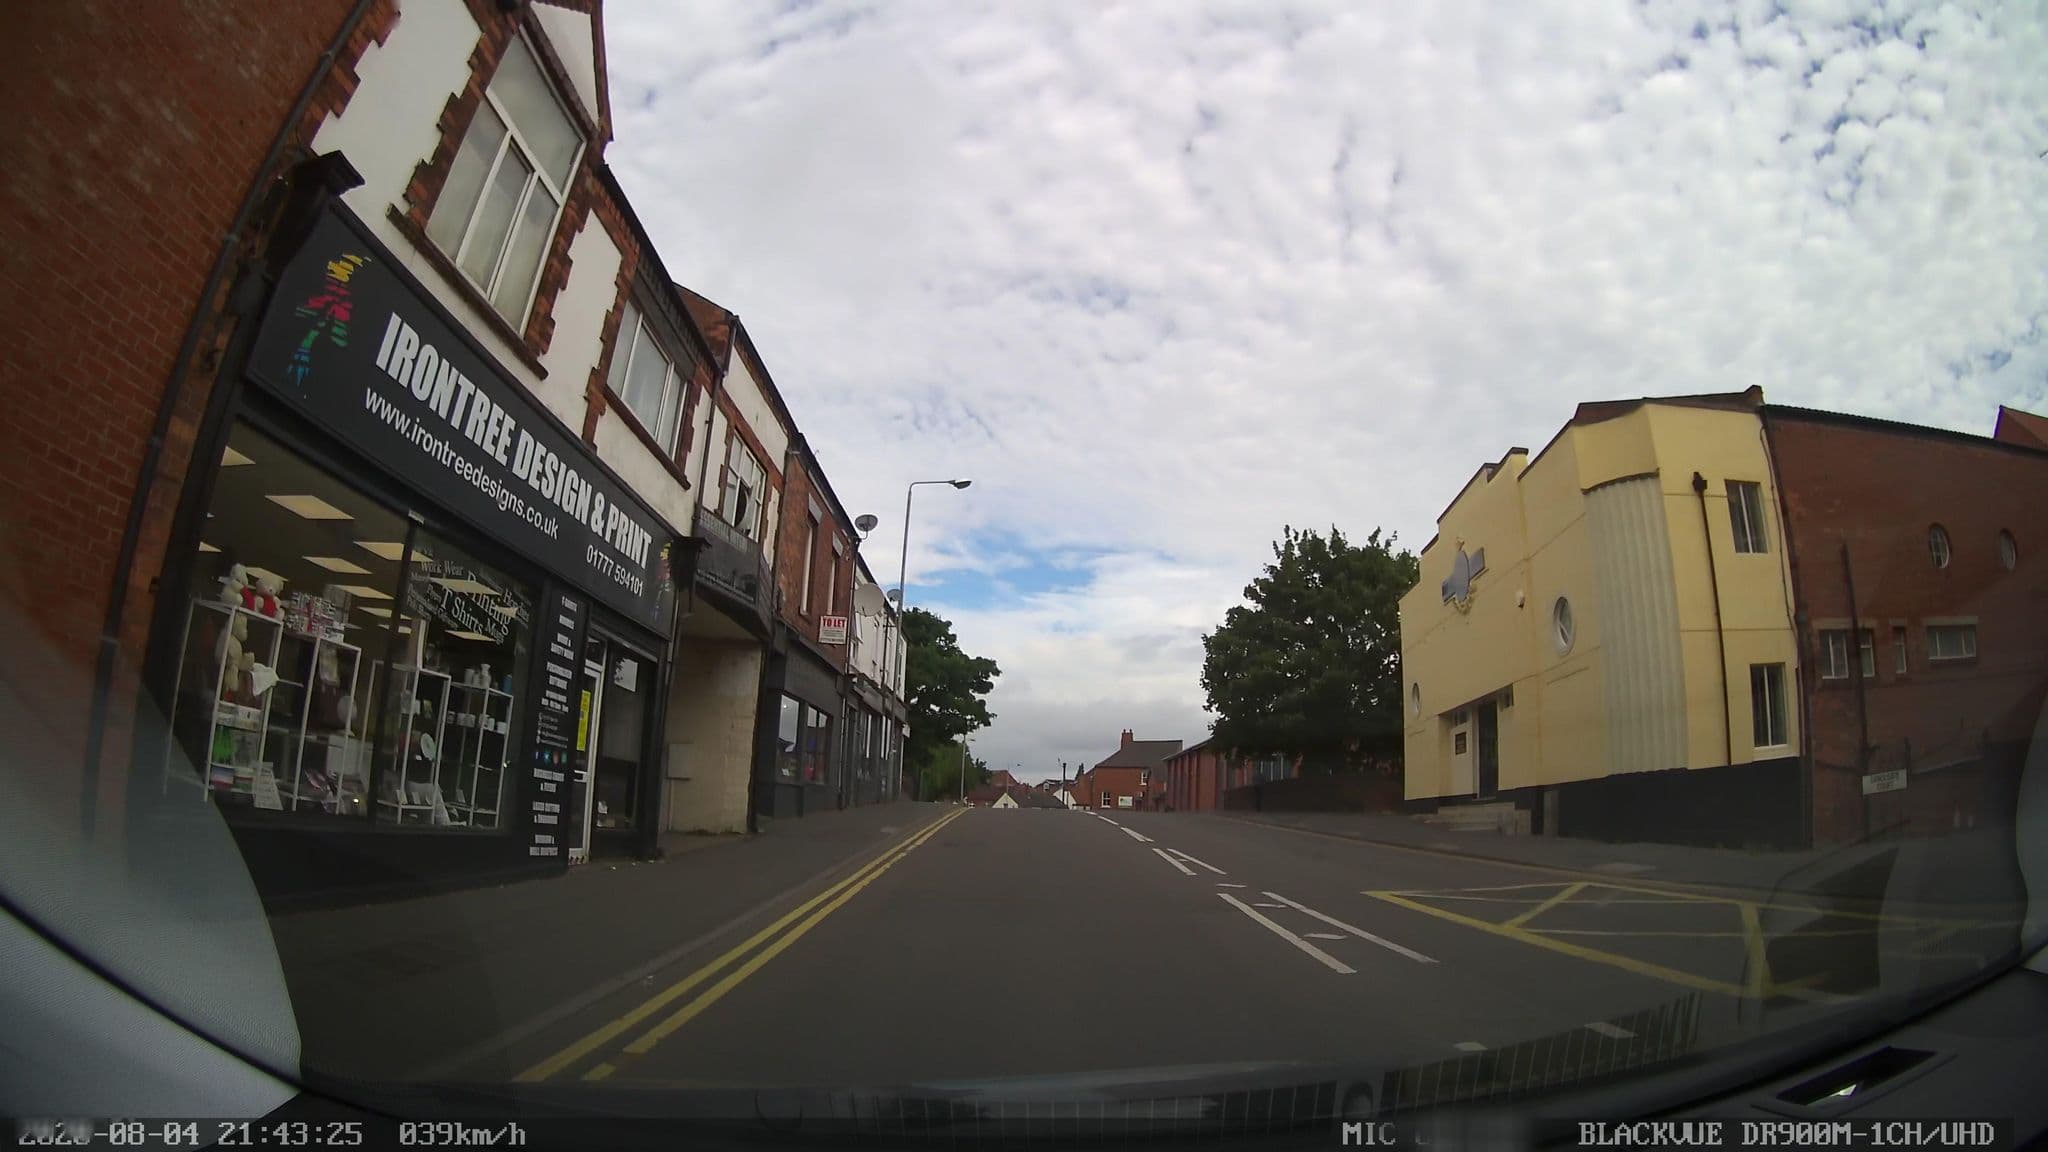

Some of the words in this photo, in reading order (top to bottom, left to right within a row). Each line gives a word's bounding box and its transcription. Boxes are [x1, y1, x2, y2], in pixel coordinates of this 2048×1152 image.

[365, 387, 559, 540] www.irontreedesigns.co.uk
[375, 311, 516, 467] IRONTREE
[511, 428, 592, 525] DESIGN
[590, 492, 605, 537] &
[604, 503, 652, 570] PRINT
[586, 544, 615, 577] 01777
[614, 564, 644, 597] 594101
[451, 596, 484, 636] Shirts
[823, 619, 832, 627] TO
[833, 619, 845, 628] LET
